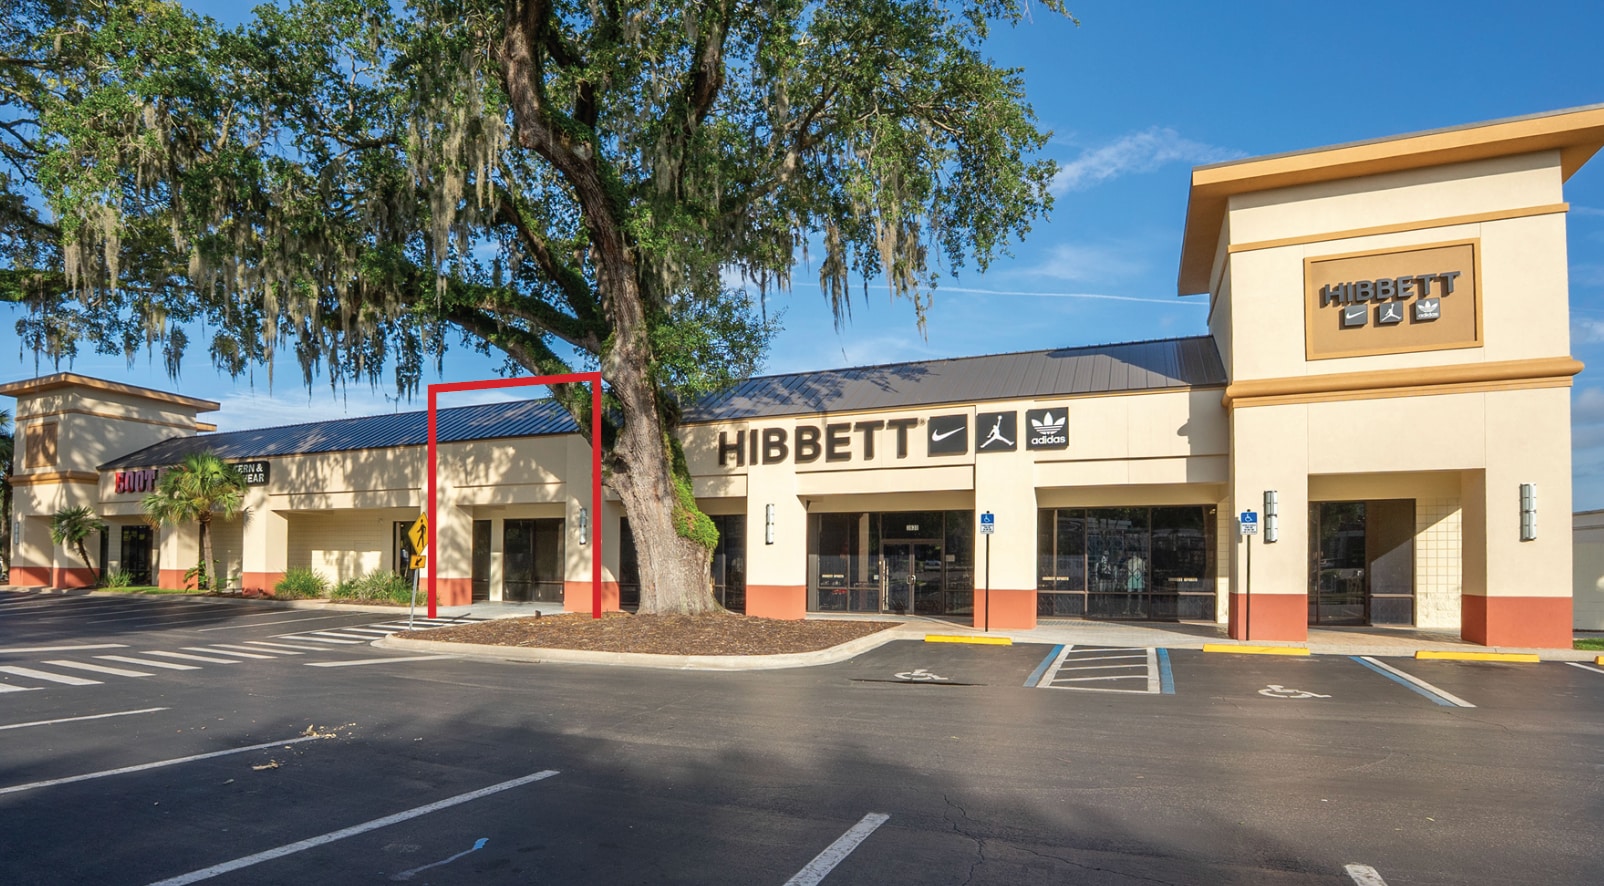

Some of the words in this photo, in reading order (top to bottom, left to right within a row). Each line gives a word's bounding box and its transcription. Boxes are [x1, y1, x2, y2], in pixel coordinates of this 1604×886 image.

[1323, 270, 1461, 305] HIBBETT
[718, 417, 918, 467] HIBBETT
[1031, 435, 1066, 445] adidas
[256, 463, 263, 472] &
